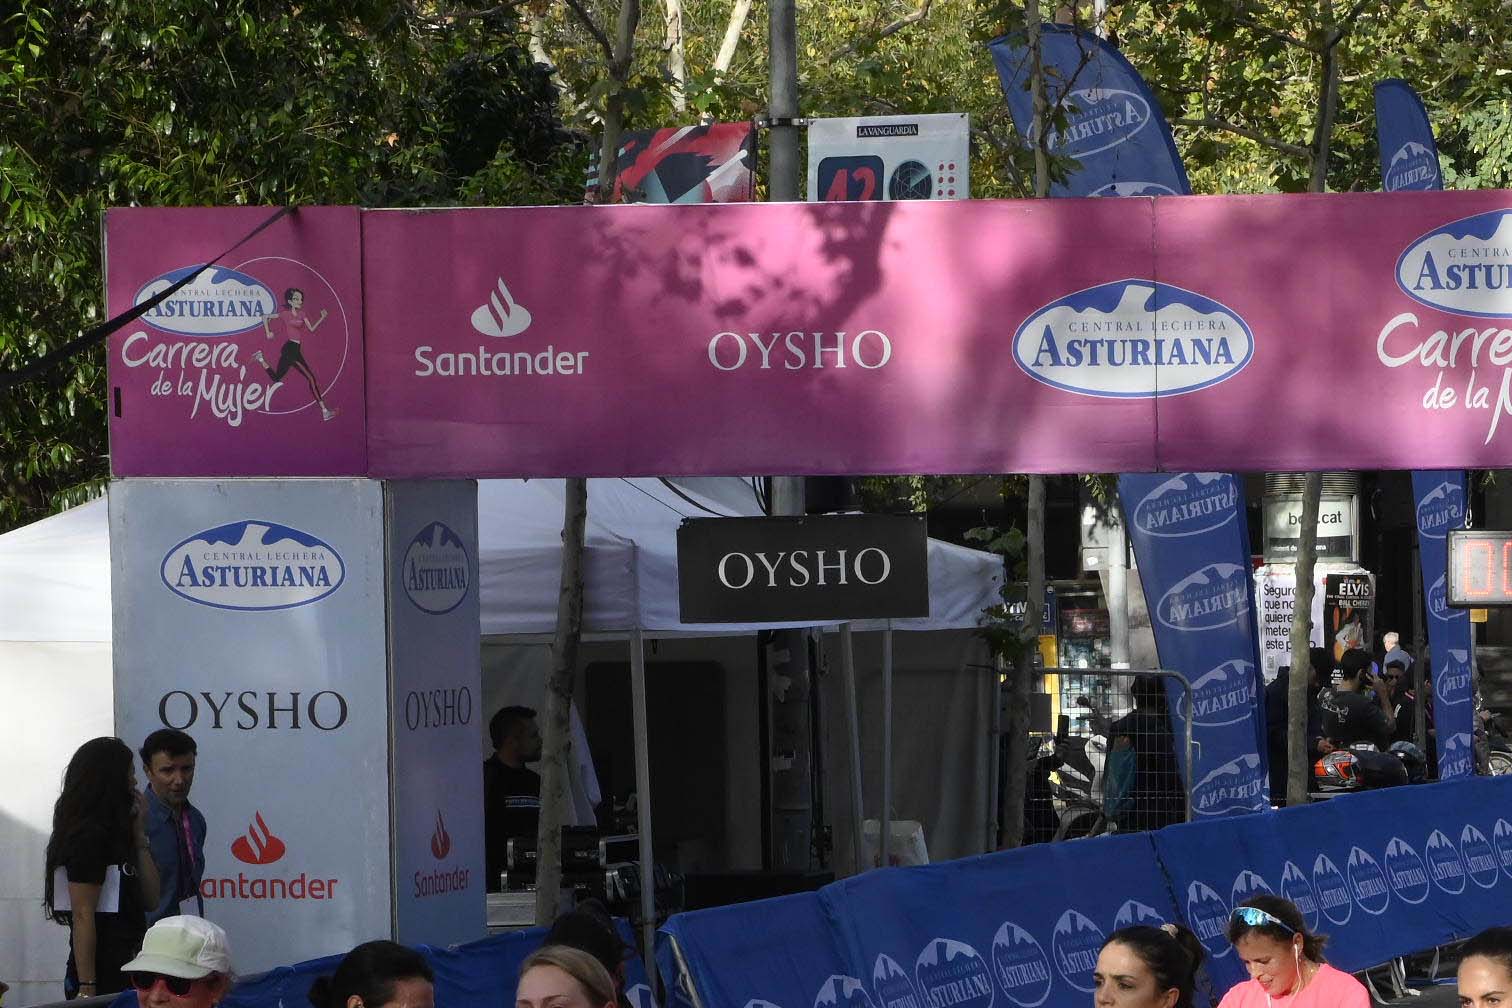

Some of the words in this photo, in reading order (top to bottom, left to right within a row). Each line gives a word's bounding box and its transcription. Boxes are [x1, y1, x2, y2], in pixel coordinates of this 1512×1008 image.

[1069, 320, 1141, 332] CENTRAL
[1149, 318, 1227, 331] LECHERA
[121, 331, 240, 369] Carrera
[415, 345, 590, 377] Santander
[708, 330, 892, 371] OYSHO
[1032, 325, 1234, 367] ASTURIANA
[151, 371, 173, 396] de
[177, 371, 193, 396] la
[191, 365, 285, 427] Mujer
[1422, 370, 1457, 409] de
[1465, 370, 1490, 409] la
[175, 555, 331, 588] ASTURIANA
[203, 552, 264, 561] CENTRAL
[267, 552, 325, 561] LECHERA
[717, 547, 891, 590] OYSHO
[408, 561, 466, 591] ASTURIANA
[1339, 583, 1369, 596] ELVIS
[1264, 600, 1281, 611] que
[1266, 640, 1285, 650] este
[158, 690, 349, 731] OYSHO
[404, 686, 472, 732] OYSHO
[200, 872, 338, 900] antander
[414, 866, 470, 899] Santander
